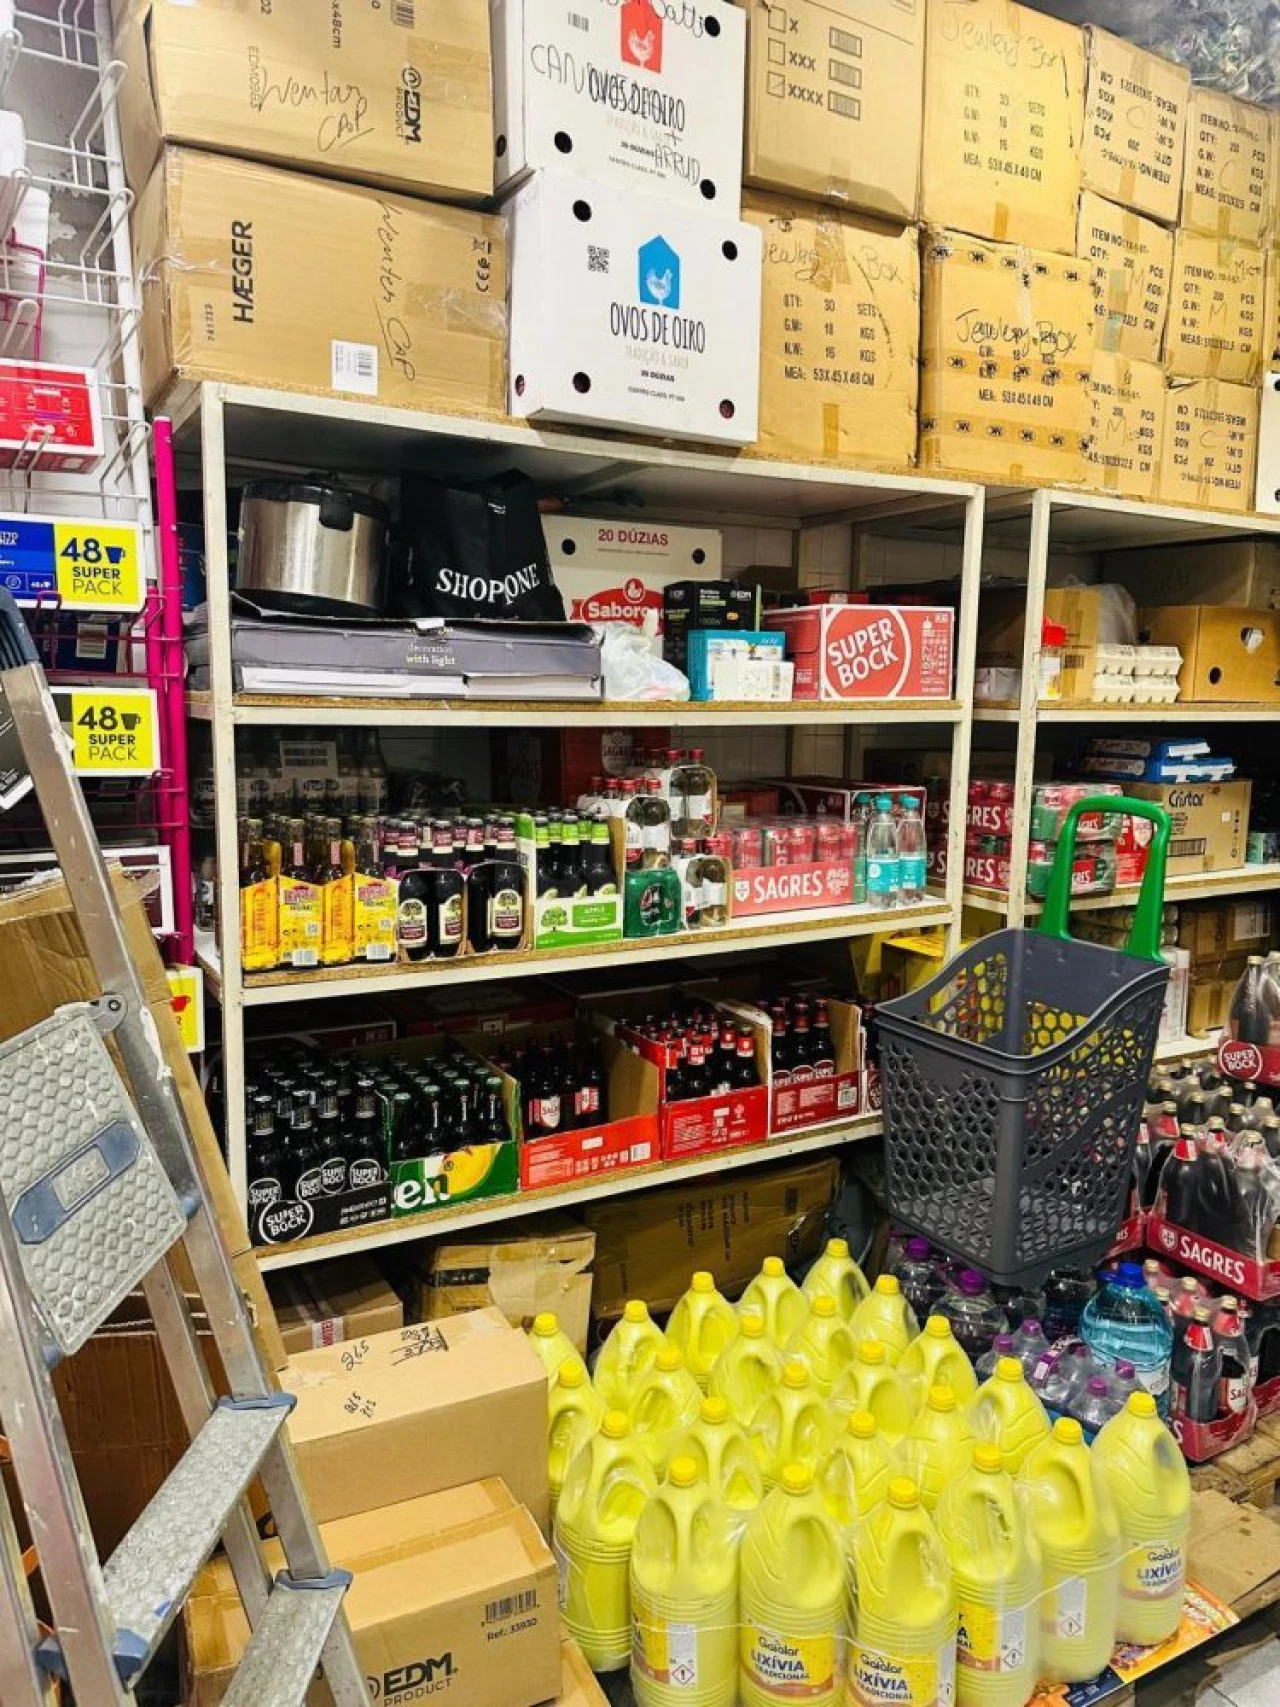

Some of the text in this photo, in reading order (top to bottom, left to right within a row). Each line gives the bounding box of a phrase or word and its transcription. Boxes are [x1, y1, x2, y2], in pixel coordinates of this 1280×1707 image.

[789, 50, 816, 72] XXX
[788, 83, 824, 107] XXXX
[404, 90, 422, 143] EDM
[232, 219, 253, 324] HÆGER
[824, 299, 835, 312] 30
[857, 303, 876, 317] SETS
[610, 302, 706, 354] OVOS DE OIRO
[860, 328, 875, 341] KGS
[860, 350, 876, 363] KGS
[599, 527, 669, 547] 20 DÚZIAS
[61, 537, 102, 563] 48
[72, 566, 121, 580] SUPER
[73, 579, 123, 597] PACK
[827, 617, 896, 667] SUPER
[406, 654, 455, 667] with light
[837, 641, 899, 688] BOCK
[78, 706, 118, 731] 48
[89, 733, 136, 746] SUPER
[89, 746, 138, 762] PACK
[754, 870, 823, 904] SAGRES
[1224, 1049, 1255, 1063] SUPER
[1228, 1059, 1256, 1072] BOCK
[265, 1205, 305, 1227] SUPER
[270, 1217, 306, 1237] BOCK
[1180, 1235, 1245, 1285] SAGRES
[751, 1648, 805, 1672] LIXÍVIA
[384, 1652, 453, 1697] EDM
[854, 1662, 908, 1691] LIXÍVIA
[384, 1677, 453, 1707] PRODUCT
